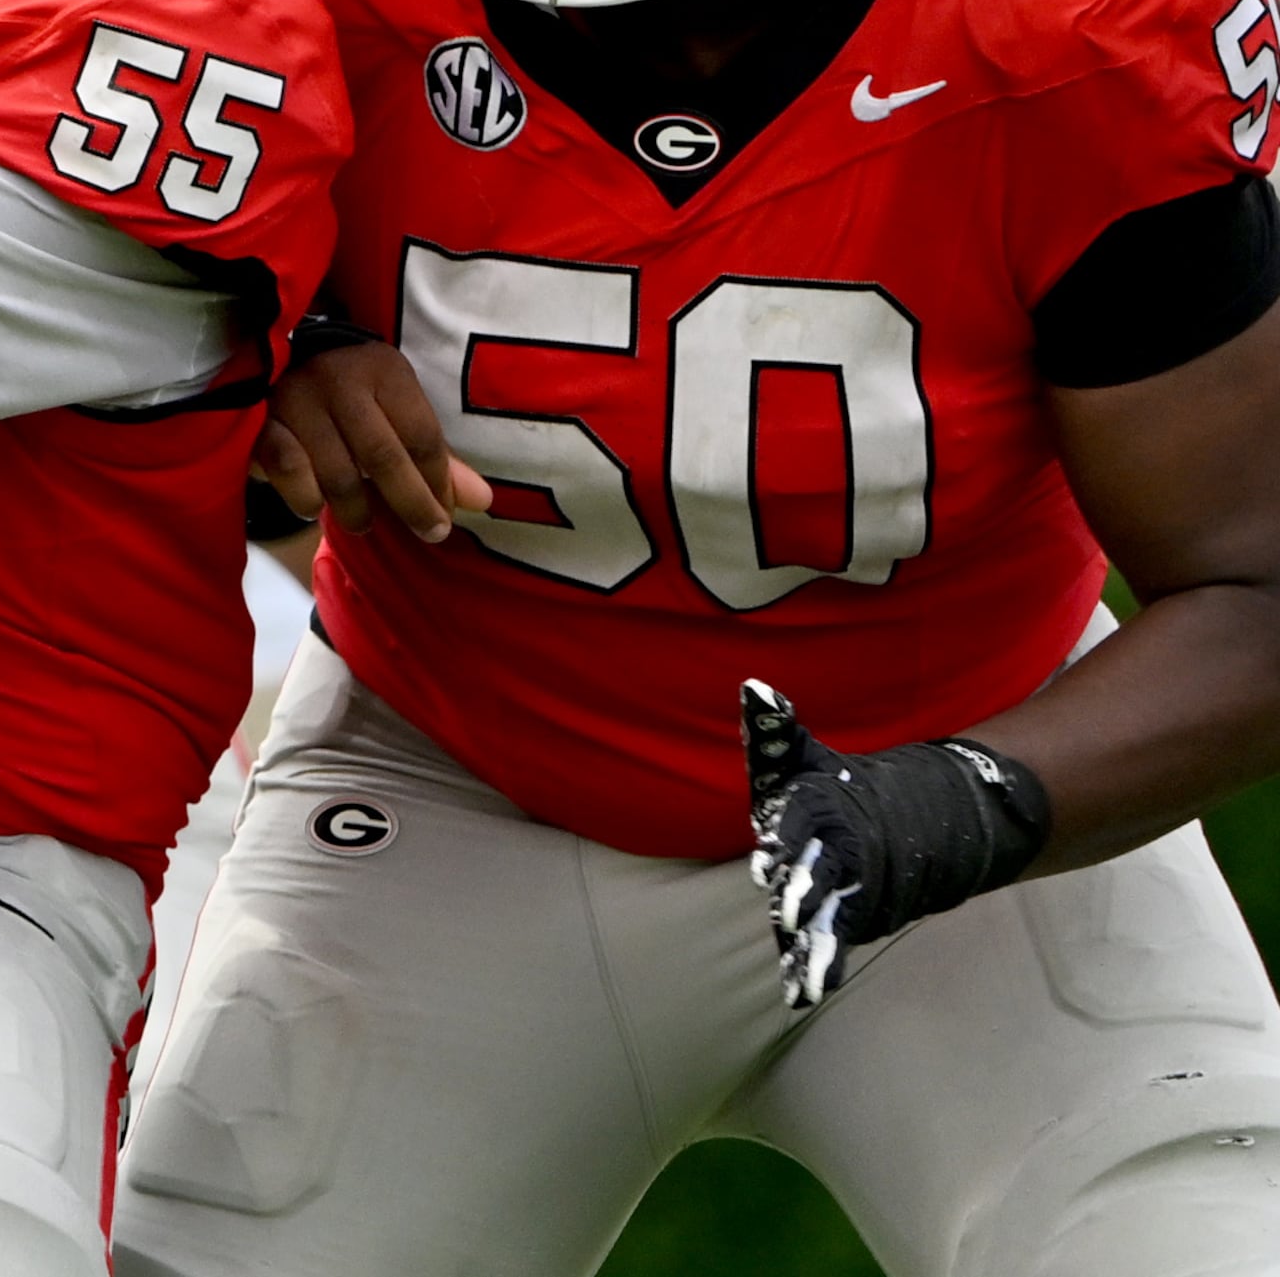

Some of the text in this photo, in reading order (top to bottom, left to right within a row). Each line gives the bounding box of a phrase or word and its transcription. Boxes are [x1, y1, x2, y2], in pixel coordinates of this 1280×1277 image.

[47, 19, 287, 224] 55
[432, 45, 517, 145] SEC
[395, 234, 934, 613] 50
